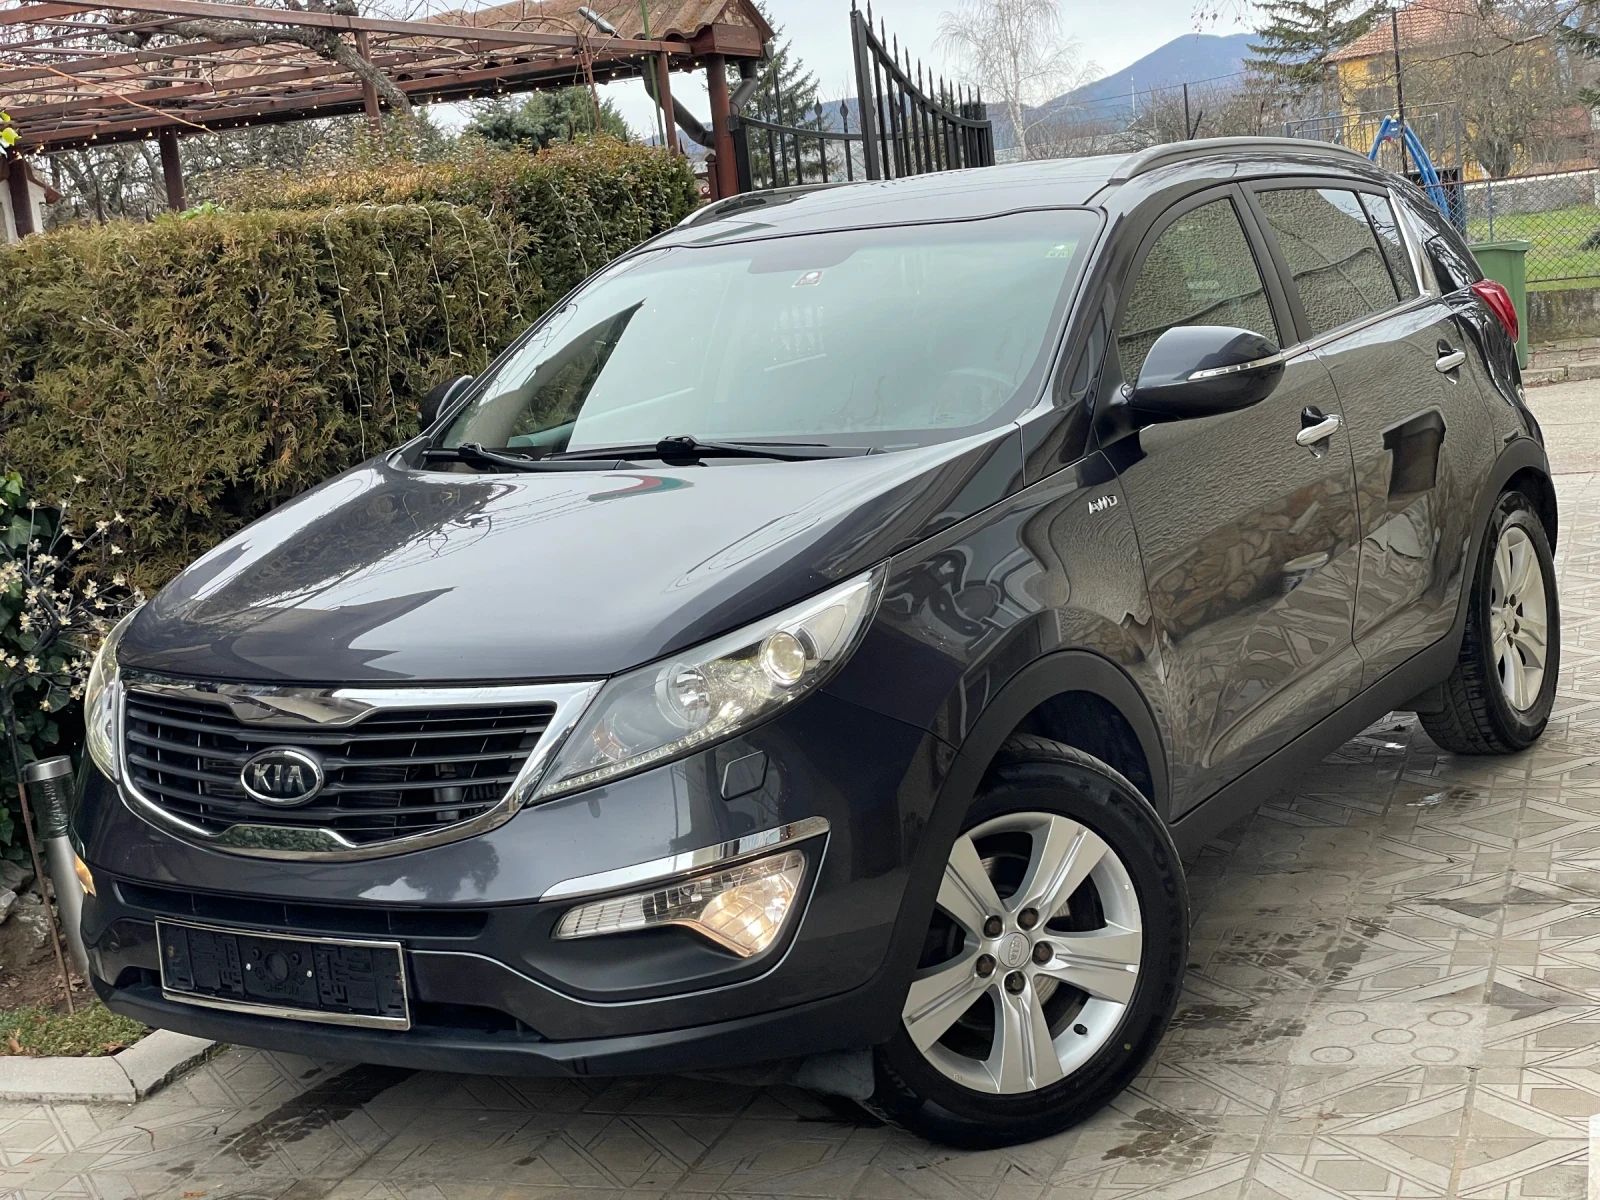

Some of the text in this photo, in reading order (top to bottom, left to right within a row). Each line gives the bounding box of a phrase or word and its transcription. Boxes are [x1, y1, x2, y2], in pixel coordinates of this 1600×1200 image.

[1088, 495, 1118, 514] AWD
[252, 763, 306, 792] KIA
[1009, 940, 1021, 961] KIA
